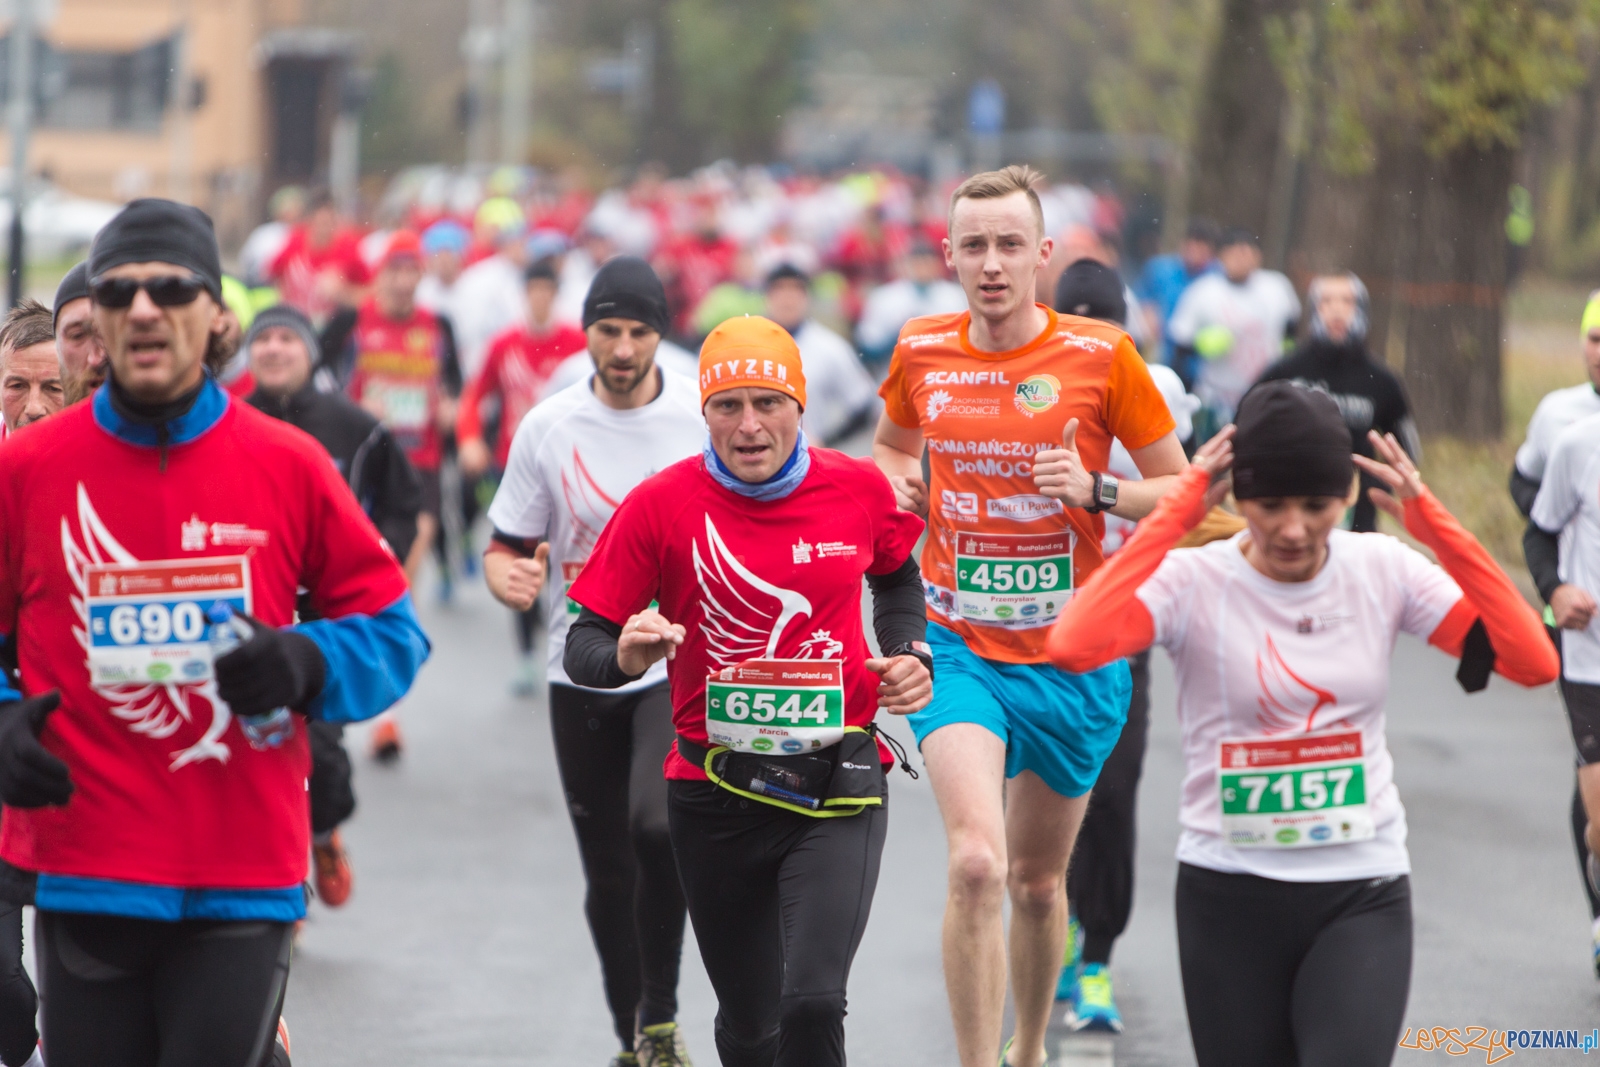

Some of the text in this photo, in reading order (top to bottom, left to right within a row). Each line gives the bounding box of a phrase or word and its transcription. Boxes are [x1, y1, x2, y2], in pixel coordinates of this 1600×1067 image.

[925, 371, 1009, 385] SCANFIL
[934, 400, 1001, 415] OGRODNICZE
[953, 397, 1001, 405] ZAOPATRZENIE
[1013, 401, 1034, 419] ACTIVE
[991, 501, 1018, 513] Piotr
[1021, 500, 1025, 511] i
[815, 542, 826, 558] 1
[979, 542, 985, 552] 1
[1017, 543, 1064, 552] RunPoland.org
[959, 570, 967, 580] C
[970, 562, 1059, 591] 4509
[990, 595, 1036, 604] Przemysław
[737, 668, 744, 678] 1
[782, 672, 833, 681] RunPoland.org
[711, 691, 829, 724] C 6544
[759, 728, 789, 736] Marcin
[1239, 768, 1353, 812] 7157
